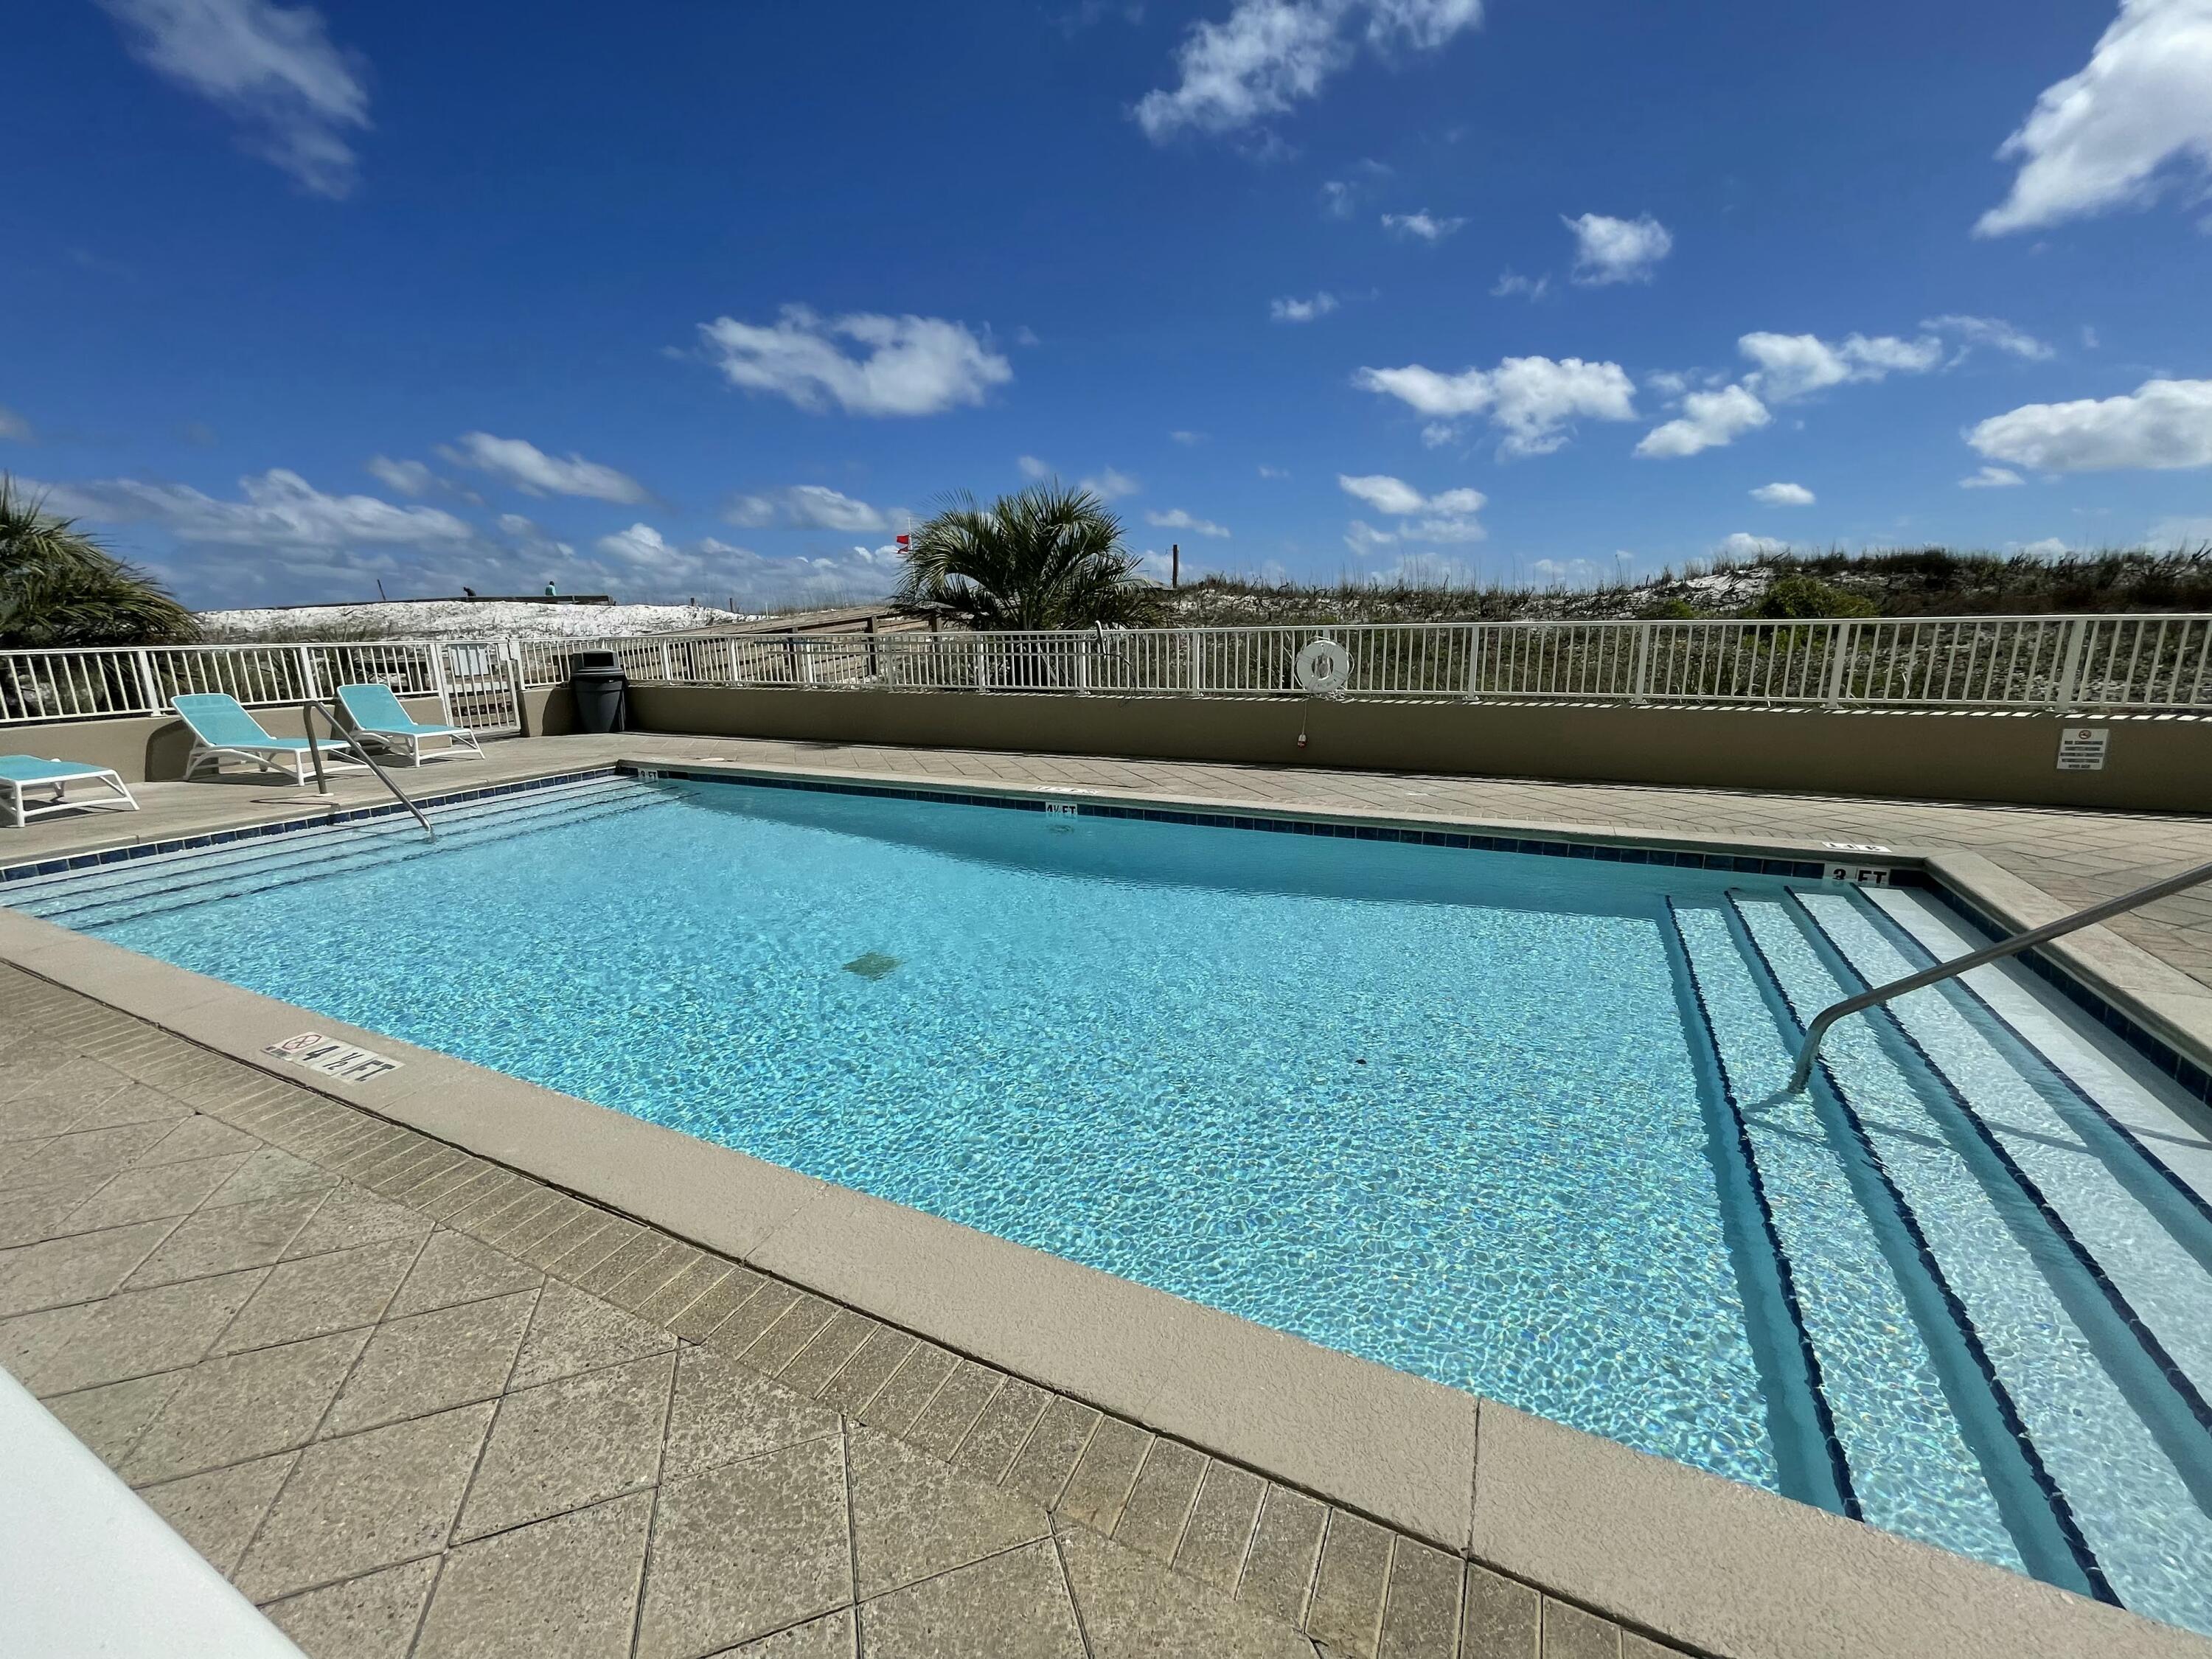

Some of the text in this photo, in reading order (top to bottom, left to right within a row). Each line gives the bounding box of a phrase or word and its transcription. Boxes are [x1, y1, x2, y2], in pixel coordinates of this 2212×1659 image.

[1062, 805, 1076, 814] FT
[1832, 868, 1888, 884] 3 FT
[302, 1045, 341, 1061] 4
[340, 1060, 397, 1082] FT
